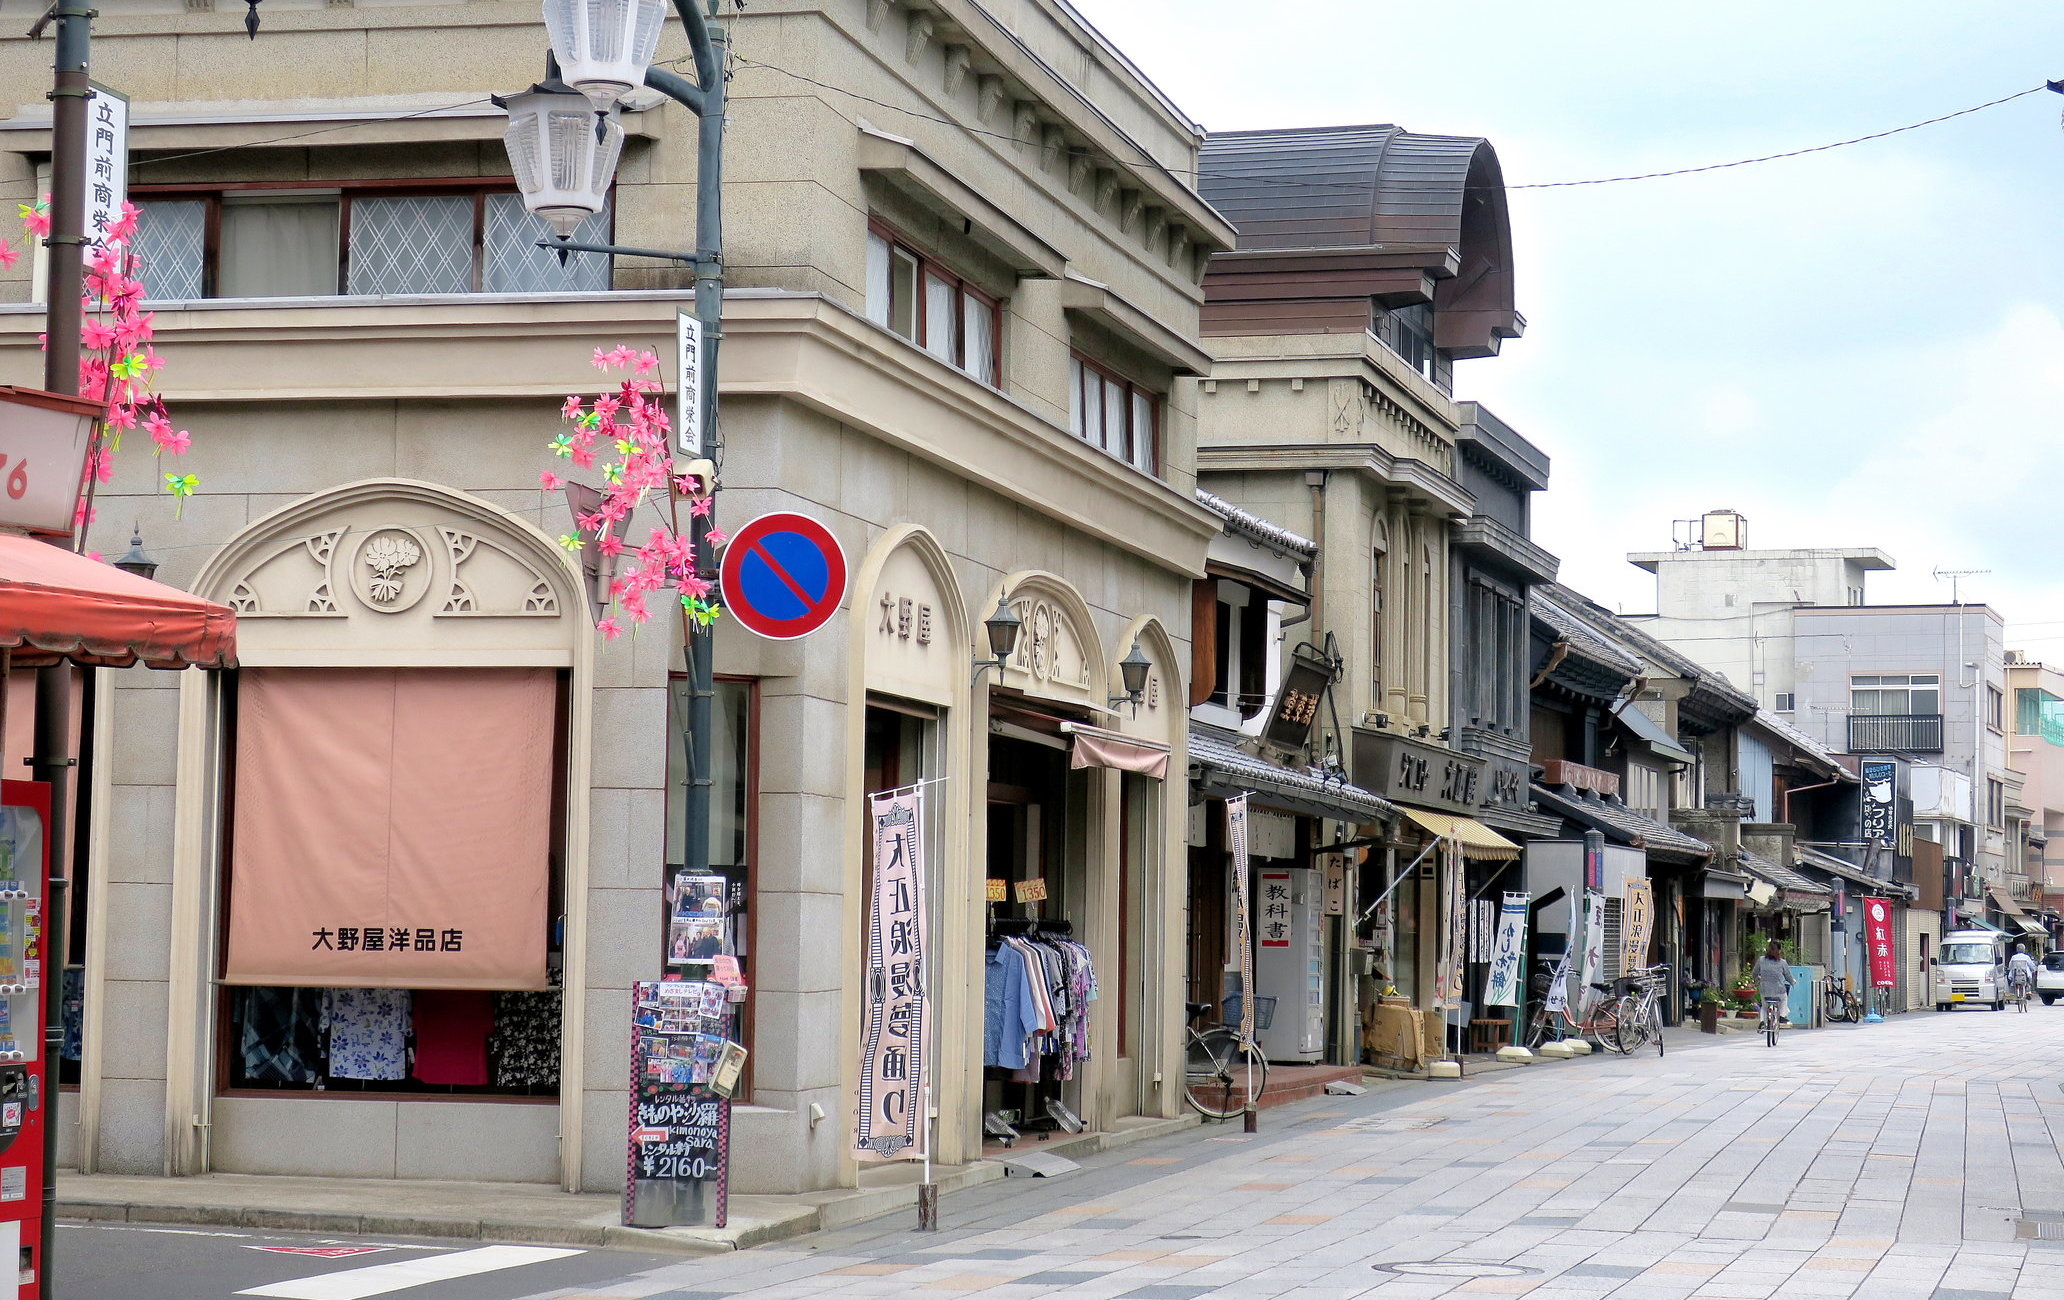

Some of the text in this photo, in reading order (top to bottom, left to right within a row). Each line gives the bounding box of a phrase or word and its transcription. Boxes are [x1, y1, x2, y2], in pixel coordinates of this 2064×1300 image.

[90, 101, 115, 258] 立門前商栄会
[684, 323, 697, 445] 立門前商栄会
[1022, 886, 1046, 900] 1350
[1328, 856, 1342, 912] たばこ
[1265, 884, 1290, 939] 教科書
[312, 926, 464, 952] 大野屋洋品店
[1875, 926, 1888, 957] 紅赤
[637, 1102, 720, 1126] きものや沙羅
[685, 1135, 714, 1150] Sara
